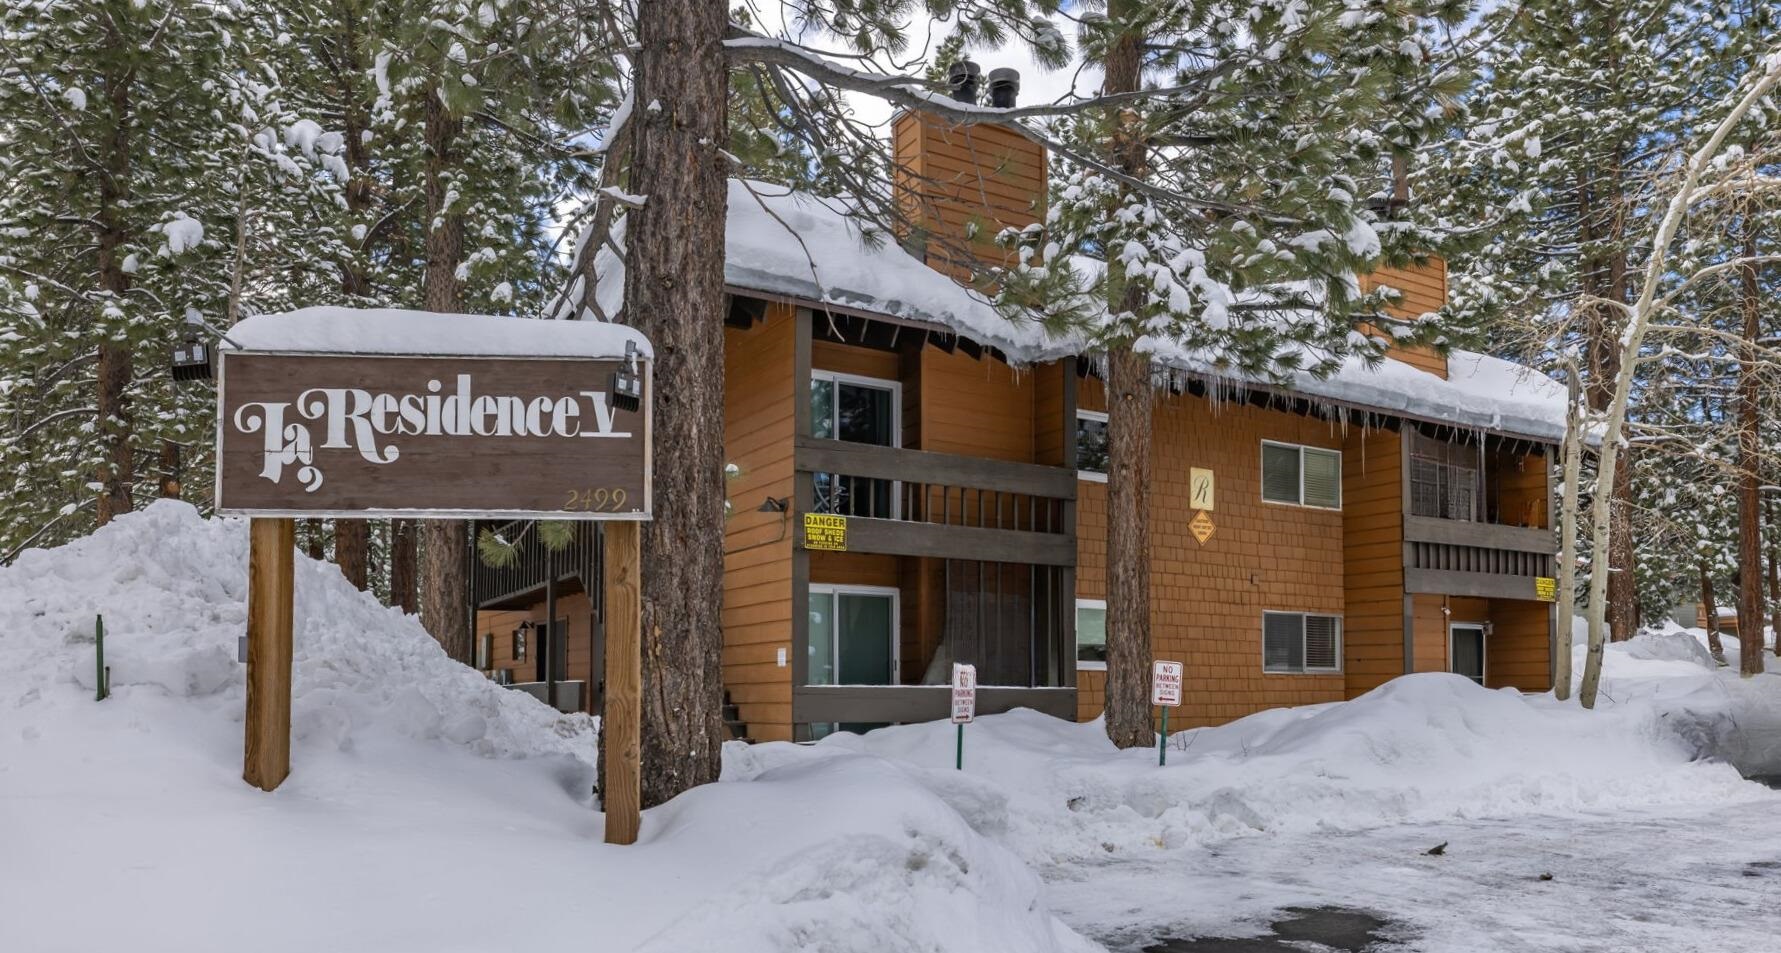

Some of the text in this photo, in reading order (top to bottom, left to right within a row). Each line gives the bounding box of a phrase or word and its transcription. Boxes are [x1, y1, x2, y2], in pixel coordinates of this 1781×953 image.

[233, 374, 632, 492] La Residence V
[1193, 475, 1209, 504] R
[563, 487, 627, 512] 2499
[805, 516, 845, 528] DANGER
[807, 527, 844, 537] ROOF SHEDS
[1163, 665, 1173, 674] NO
[1156, 673, 1179, 683] PARKING
[1156, 682, 1178, 690] BETWEEN
[955, 689, 973, 698] PARKING
